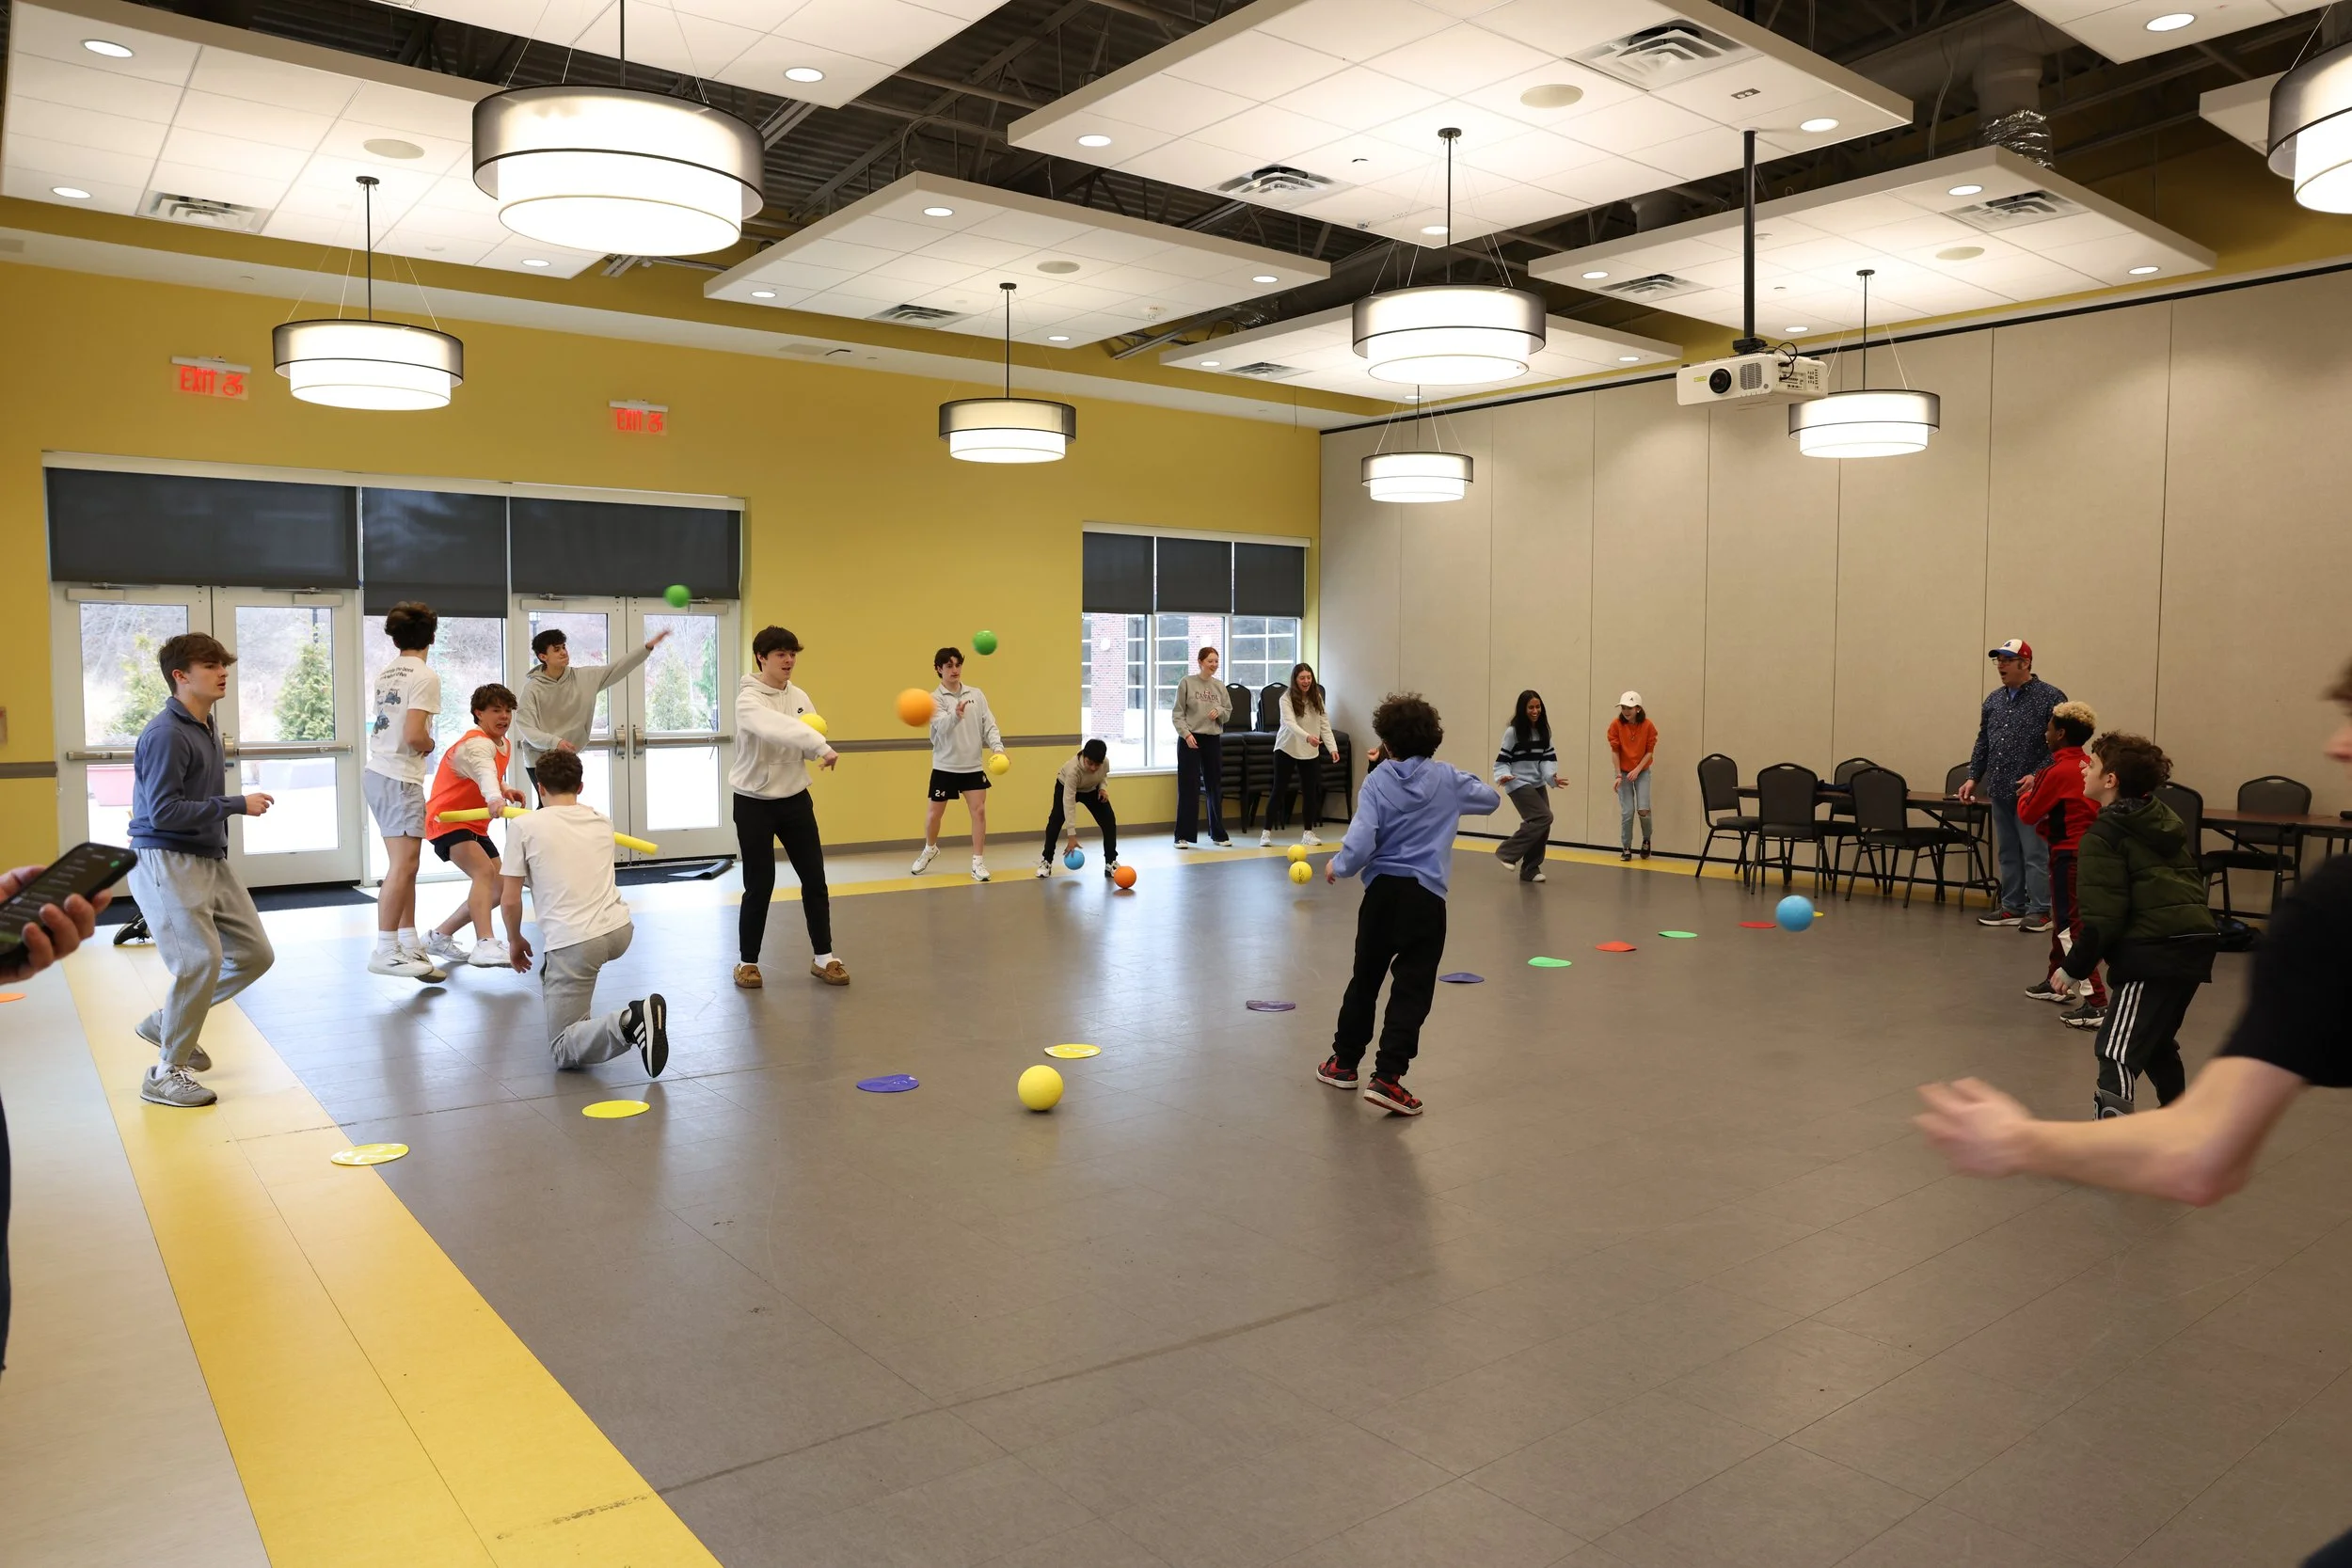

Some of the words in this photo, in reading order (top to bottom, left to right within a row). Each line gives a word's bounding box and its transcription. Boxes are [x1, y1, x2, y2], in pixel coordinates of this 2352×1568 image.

[181, 365, 218, 395] EXIT
[616, 408, 644, 431] EXIT
[934, 789, 946, 798] 24
